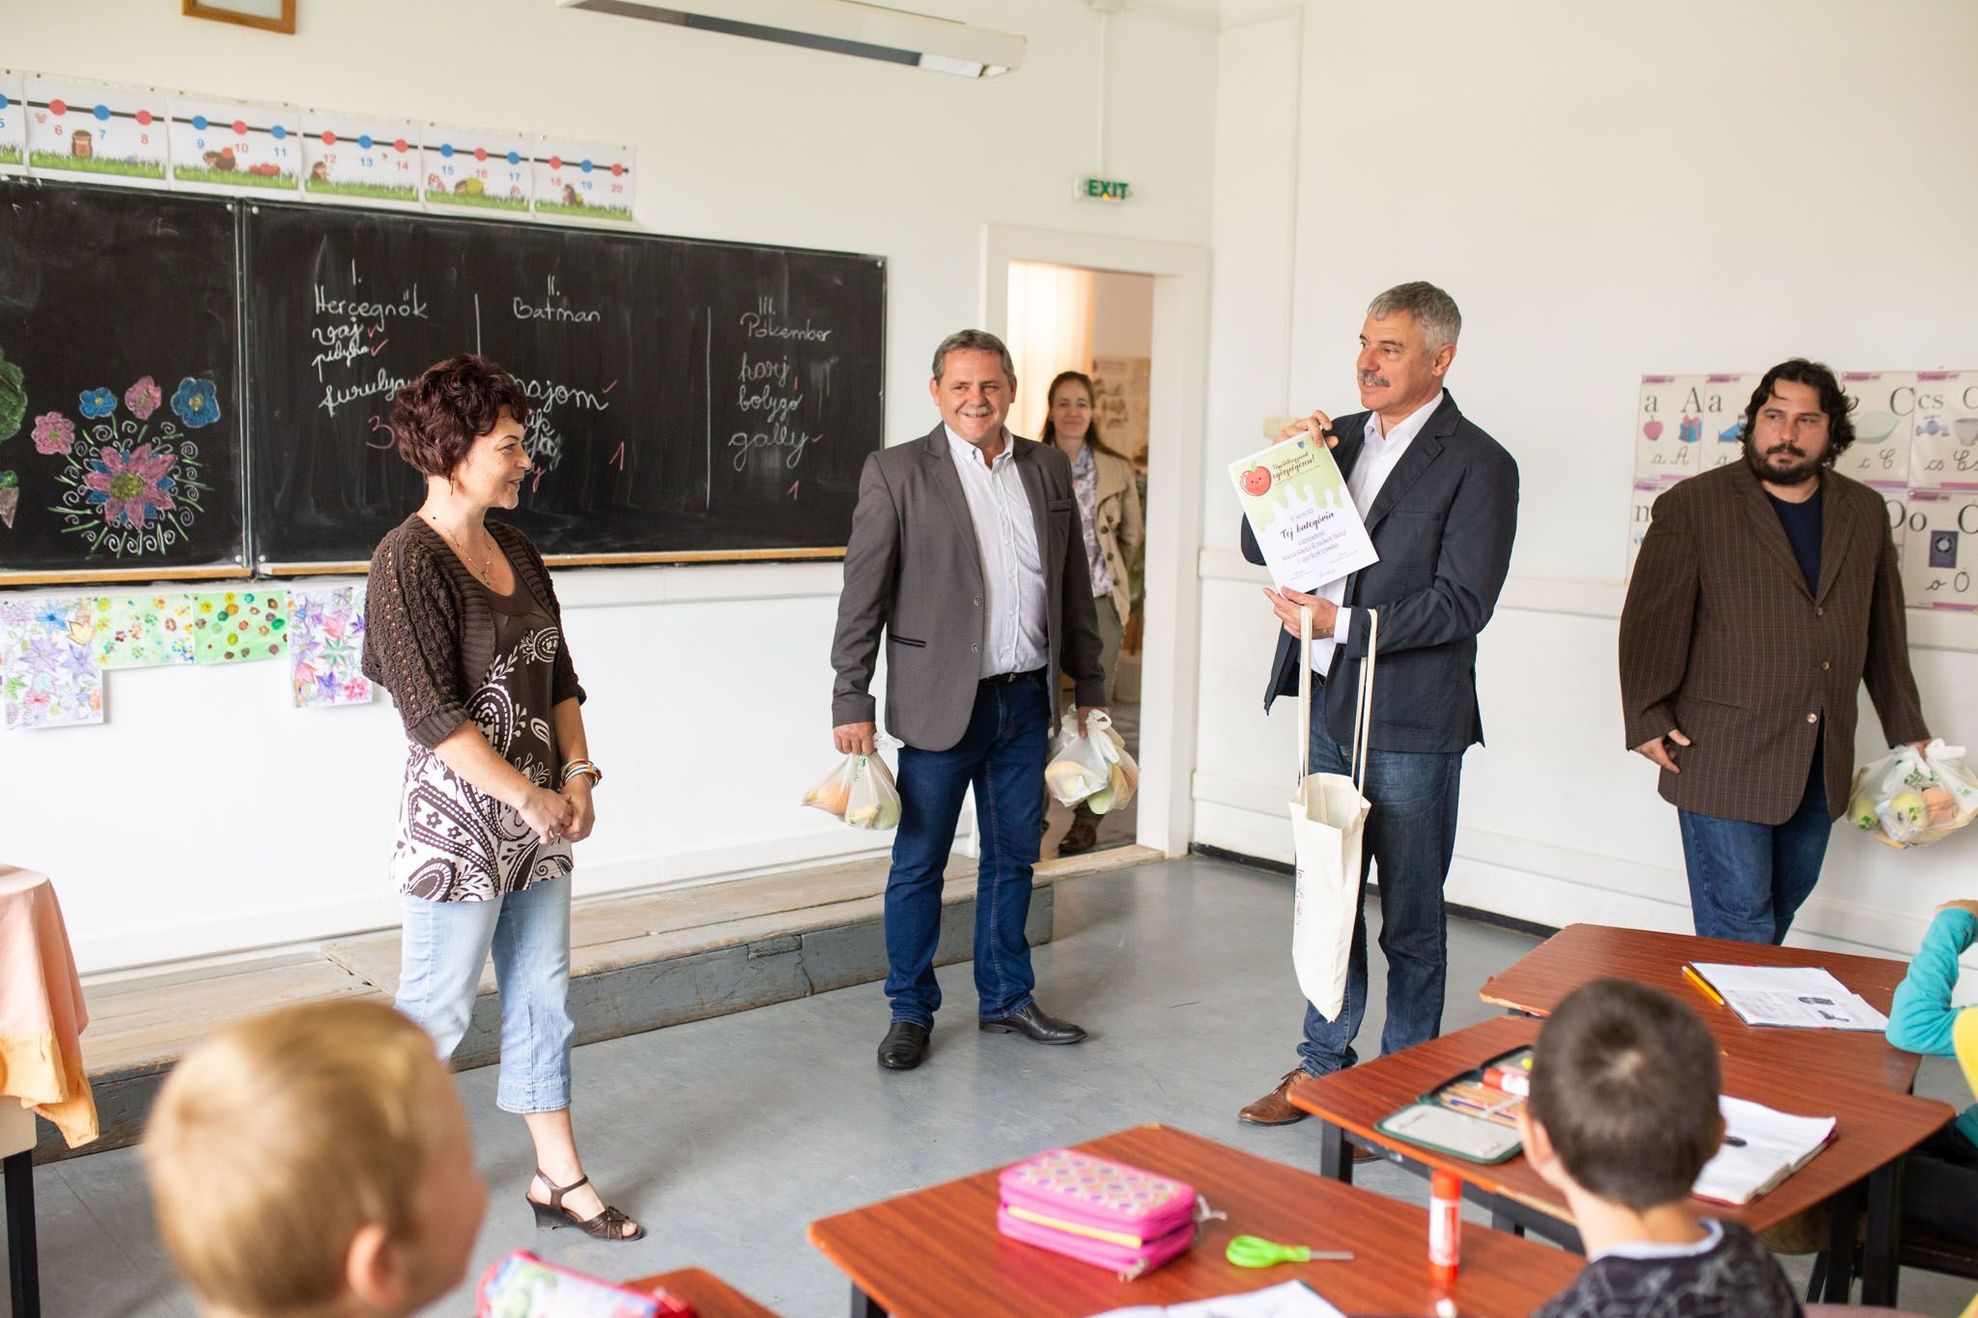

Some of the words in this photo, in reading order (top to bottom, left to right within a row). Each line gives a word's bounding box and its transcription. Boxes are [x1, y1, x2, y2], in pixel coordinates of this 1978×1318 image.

[54, 125, 62, 136] 6
[99, 129, 106, 139] 7
[141, 134, 149, 145] 8
[196, 139, 204, 149] 9
[235, 143, 248, 153] 10
[274, 146, 287, 157] 11
[323, 153, 336, 164] 12
[360, 157, 373, 168] 13
[395, 161, 408, 170] 14
[441, 165, 454, 175] 15
[475, 169, 487, 179] 16
[509, 172, 520, 182] 17
[550, 177, 561, 186] 18
[581, 181, 593, 190] 19
[611, 184, 622, 193] 20
[1088, 179, 1129, 200] EXIT
[314, 283, 428, 332] Hercegnők
[512, 296, 601, 322] Batman
[1644, 394, 1658, 413] a
[1681, 387, 1702, 413] A
[1708, 394, 1723, 413] a
[1889, 386, 1916, 417] C
[1918, 394, 1944, 410] cs
[366, 415, 395, 449] 3
[609, 441, 624, 471] 1
[728, 422, 808, 472] gally
[787, 480, 799, 500] 1
[1280, 528, 1294, 541] Tej
[1296, 511, 1335, 533] kategória
[1909, 512, 1927, 532] o
